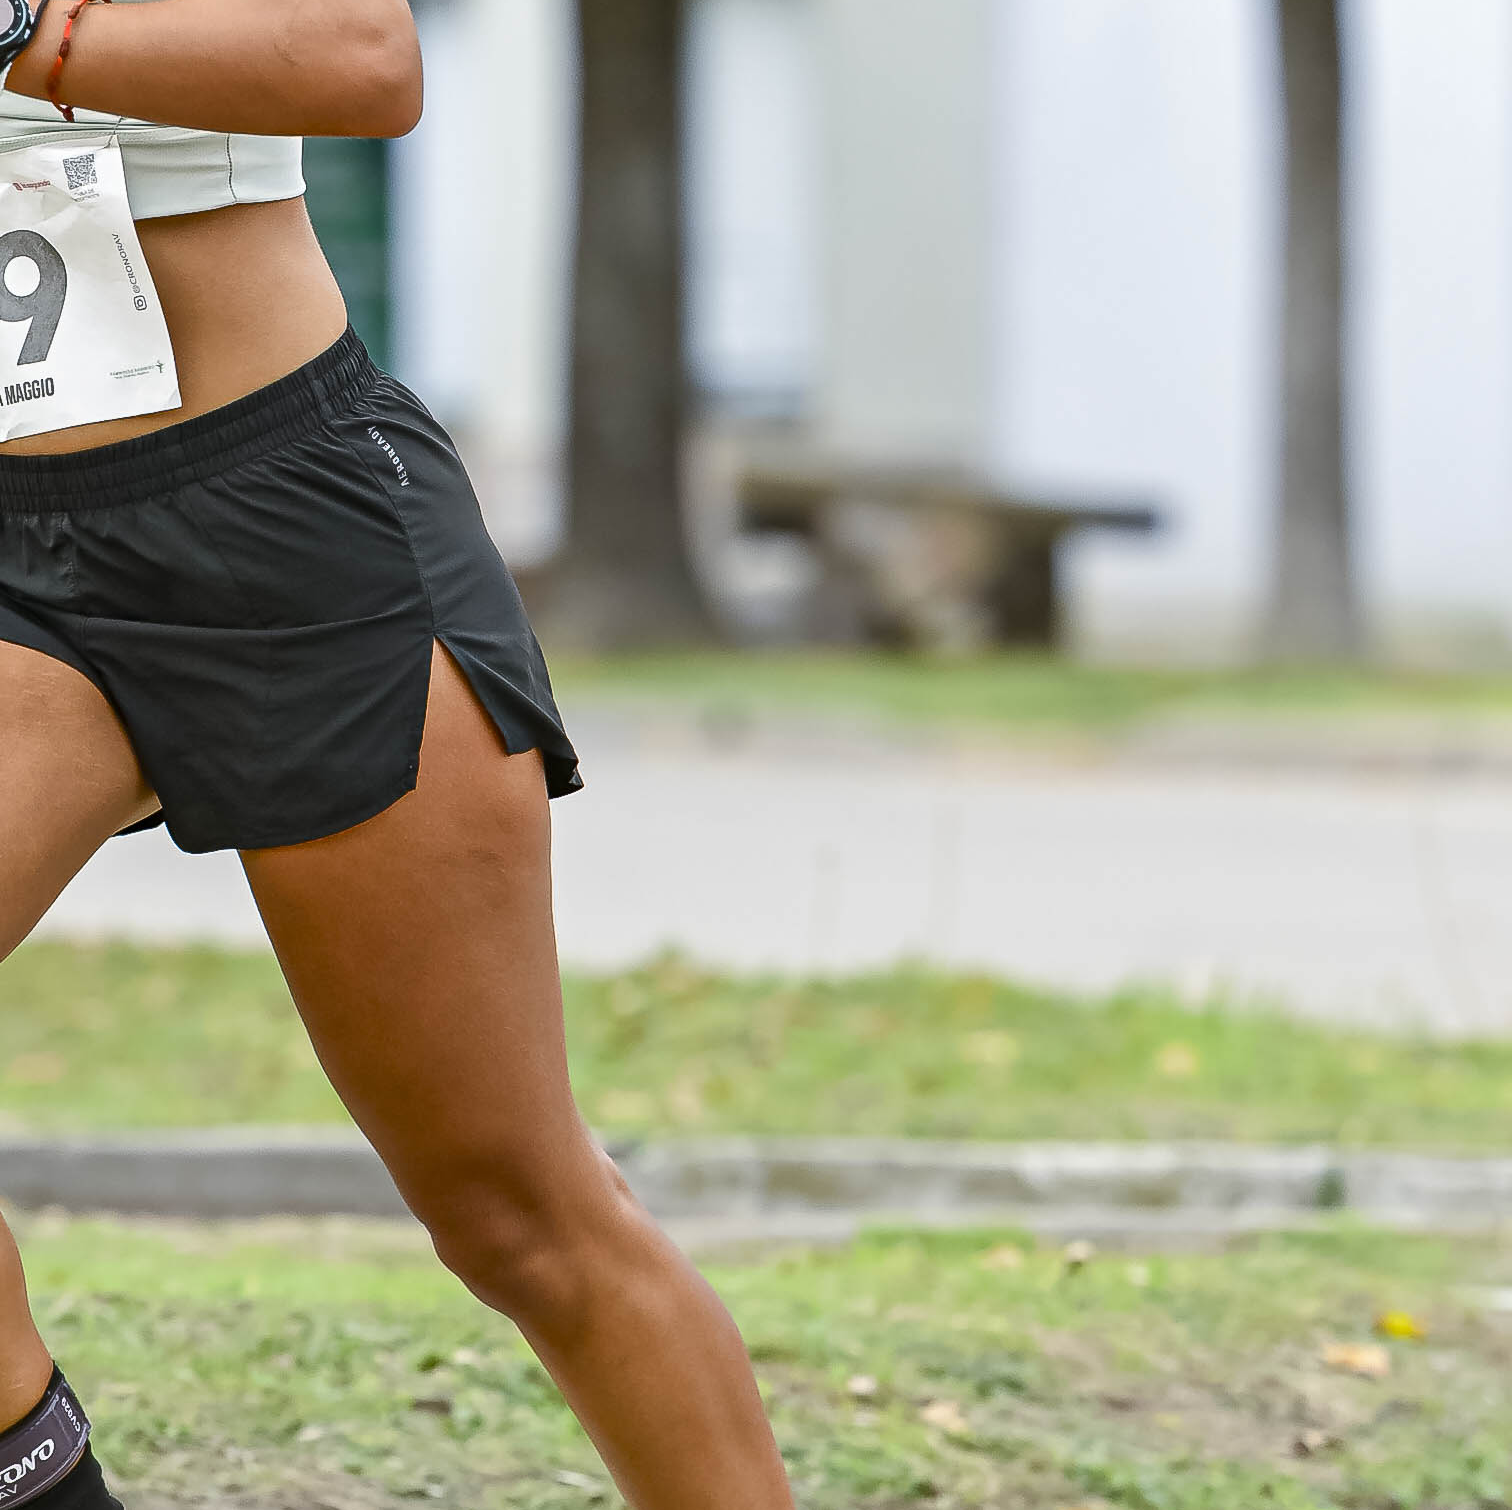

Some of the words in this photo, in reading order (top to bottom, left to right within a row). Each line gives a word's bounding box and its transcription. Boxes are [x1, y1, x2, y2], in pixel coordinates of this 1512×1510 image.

[112, 233, 141, 293] @CRONORAV
[4, 377, 55, 406] MAGGIO
[367, 426, 410, 487] AEROREADY
